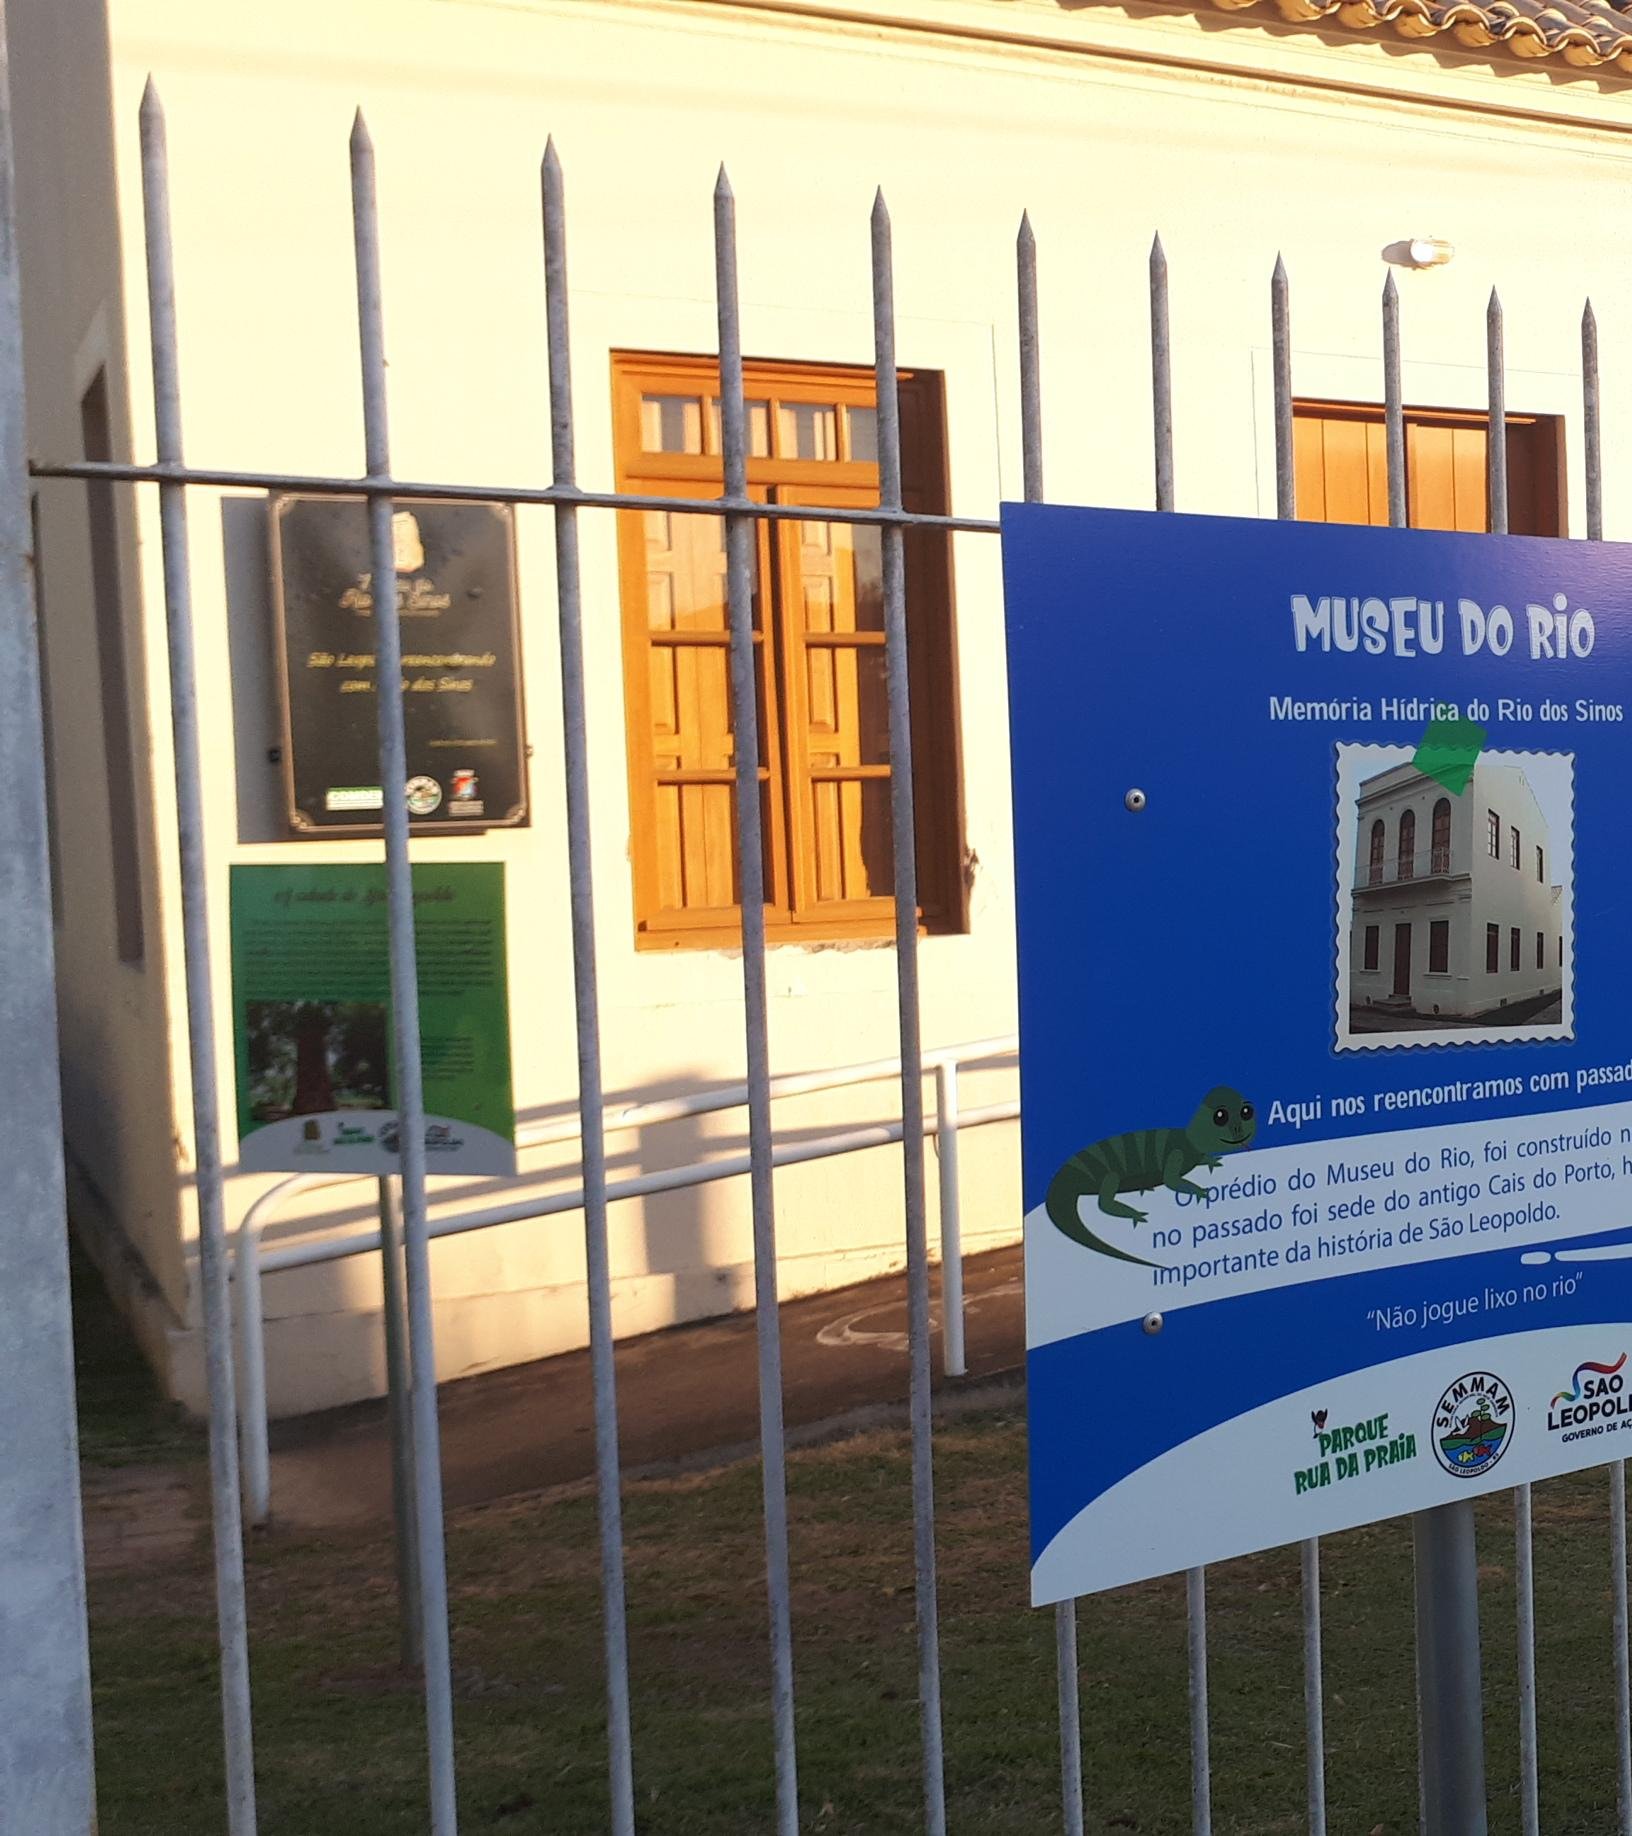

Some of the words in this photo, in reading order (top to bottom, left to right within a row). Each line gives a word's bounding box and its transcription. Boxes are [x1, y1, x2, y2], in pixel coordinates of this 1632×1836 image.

[1291, 594, 1444, 657] MUSEU
[1459, 599, 1513, 656] DO
[1269, 696, 1372, 721] Memória
[1381, 698, 1459, 721] Hídrica
[1467, 698, 1489, 721] do
[1498, 698, 1532, 721] Rio
[1540, 699, 1568, 722] dos
[1576, 699, 1623, 722] Sinos
[1268, 1095, 1321, 1129] Aqui
[1331, 1094, 1365, 1117] nos
[1373, 1077, 1523, 1111] reencontramos
[1530, 1072, 1569, 1091] com
[1205, 1174, 1277, 1209] prédio
[1288, 1168, 1315, 1191] do
[1327, 1160, 1394, 1186] Museu
[1405, 1152, 1430, 1175] do
[1441, 1147, 1475, 1169] Rio,
[1484, 1141, 1507, 1163] foi
[1517, 1127, 1611, 1158] construído
[1152, 1228, 1181, 1248] no
[1192, 1209, 1282, 1247] passado
[1292, 1203, 1318, 1226] foi
[1328, 1195, 1375, 1221] sede
[1384, 1190, 1410, 1211] do
[1418, 1180, 1480, 1207] antigo
[1489, 1173, 1525, 1195] Cais
[1533, 1168, 1556, 1188] do
[1565, 1162, 1615, 1185] Porto,
[1153, 1249, 1278, 1286] importante
[1285, 1241, 1311, 1263] da
[1318, 1227, 1392, 1258] história
[1399, 1222, 1423, 1245] de
[1429, 1216, 1463, 1239] São
[1470, 1201, 1560, 1233] Leopoldo.
[1421, 1296, 1479, 1329] jogue
[1485, 1288, 1517, 1310] lixo
[1523, 1284, 1547, 1303] no
[1436, 1376, 1510, 1428] SEMMAM
[1318, 1412, 1388, 1458] PARQUE
[1562, 1426, 1603, 1443] GOVERNO
[1606, 1422, 1618, 1432] DE
[1294, 1461, 1331, 1496] RUA
[1335, 1452, 1359, 1480] DA
